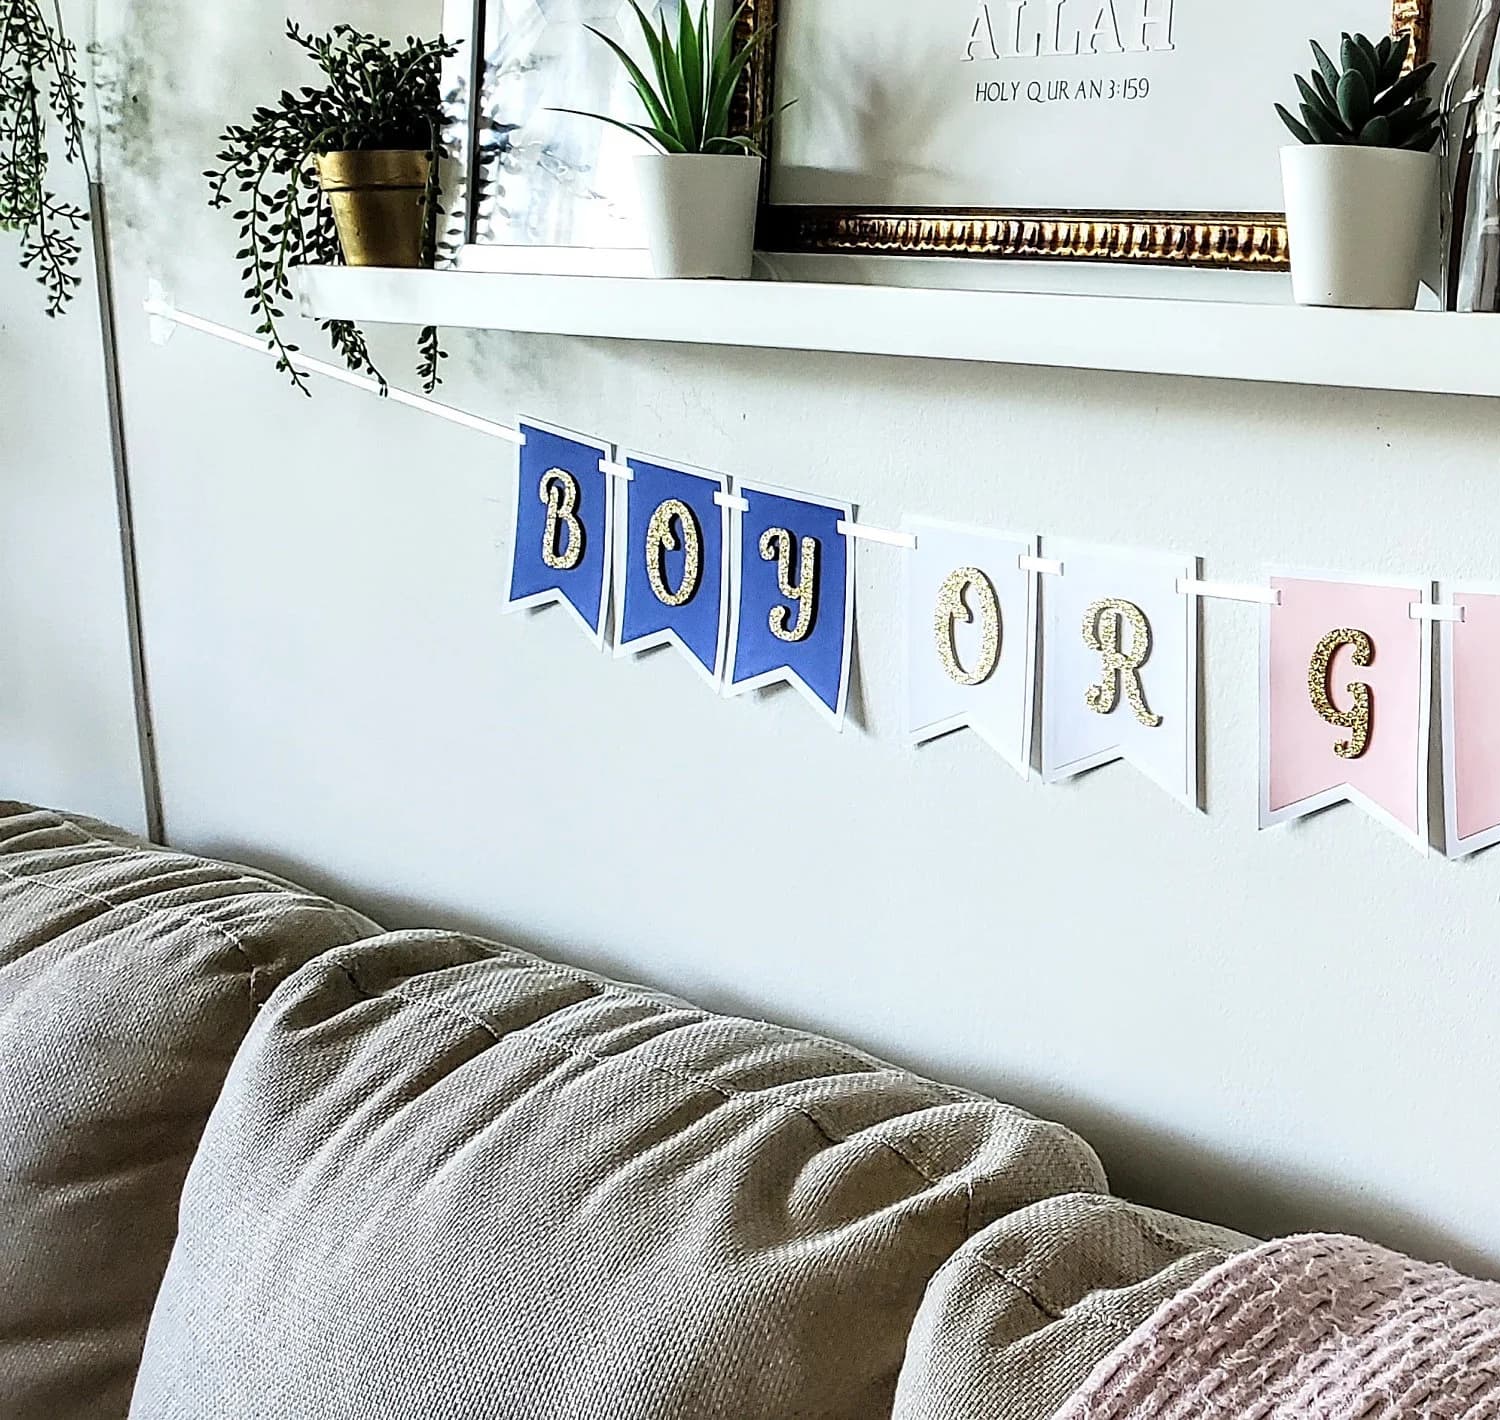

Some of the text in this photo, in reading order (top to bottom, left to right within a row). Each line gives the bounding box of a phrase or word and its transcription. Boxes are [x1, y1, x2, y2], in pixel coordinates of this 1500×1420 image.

[959, 0, 1175, 61] ALLAH
[975, 80, 1020, 102] HOLY
[1108, 77, 1150, 99] 3:159
[539, 466, 817, 643] BOY
[936, 565, 1164, 728] OR
